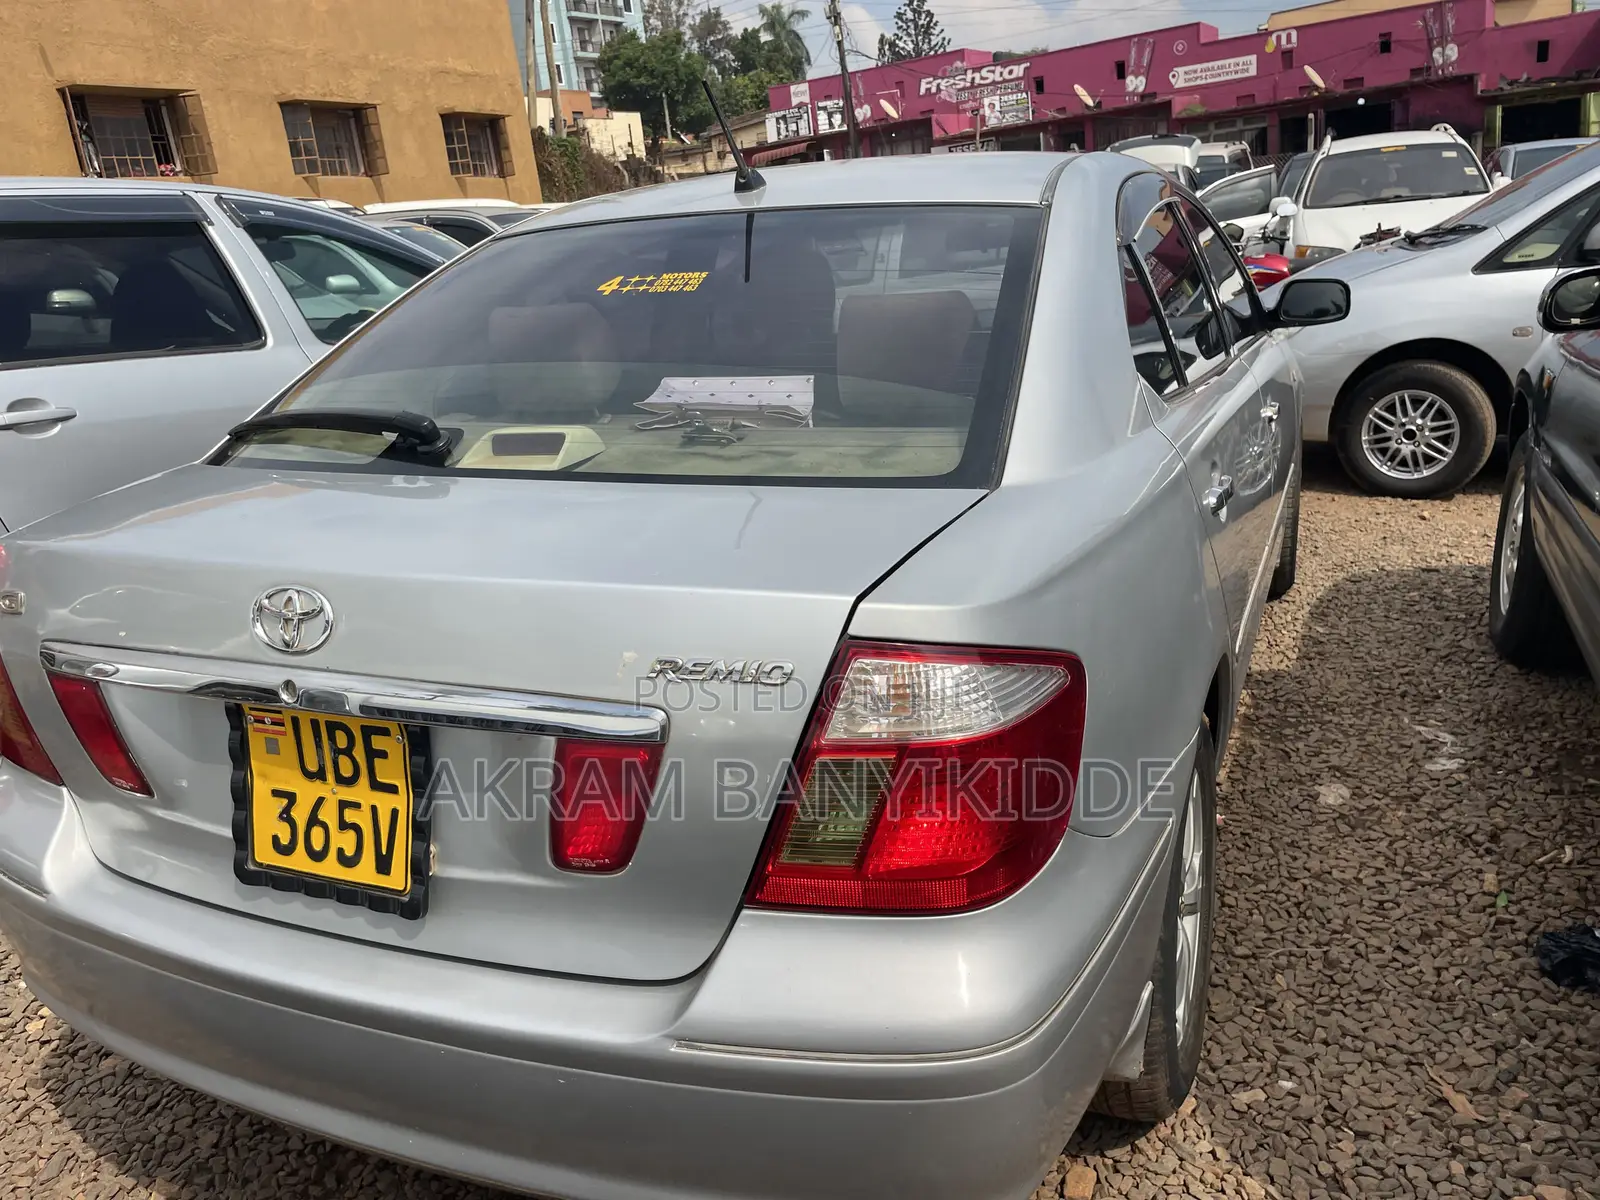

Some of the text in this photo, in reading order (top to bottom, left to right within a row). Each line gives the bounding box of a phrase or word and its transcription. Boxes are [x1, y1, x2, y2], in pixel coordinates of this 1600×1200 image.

[918, 61, 1031, 97] FreshStar
[1183, 59, 1254, 77] NOW AVAILABLE IN ALL
[596, 275, 625, 296] 4
[660, 271, 710, 280] MOTORS
[290, 715, 400, 796] UBE
[270, 788, 401, 877] 365V
